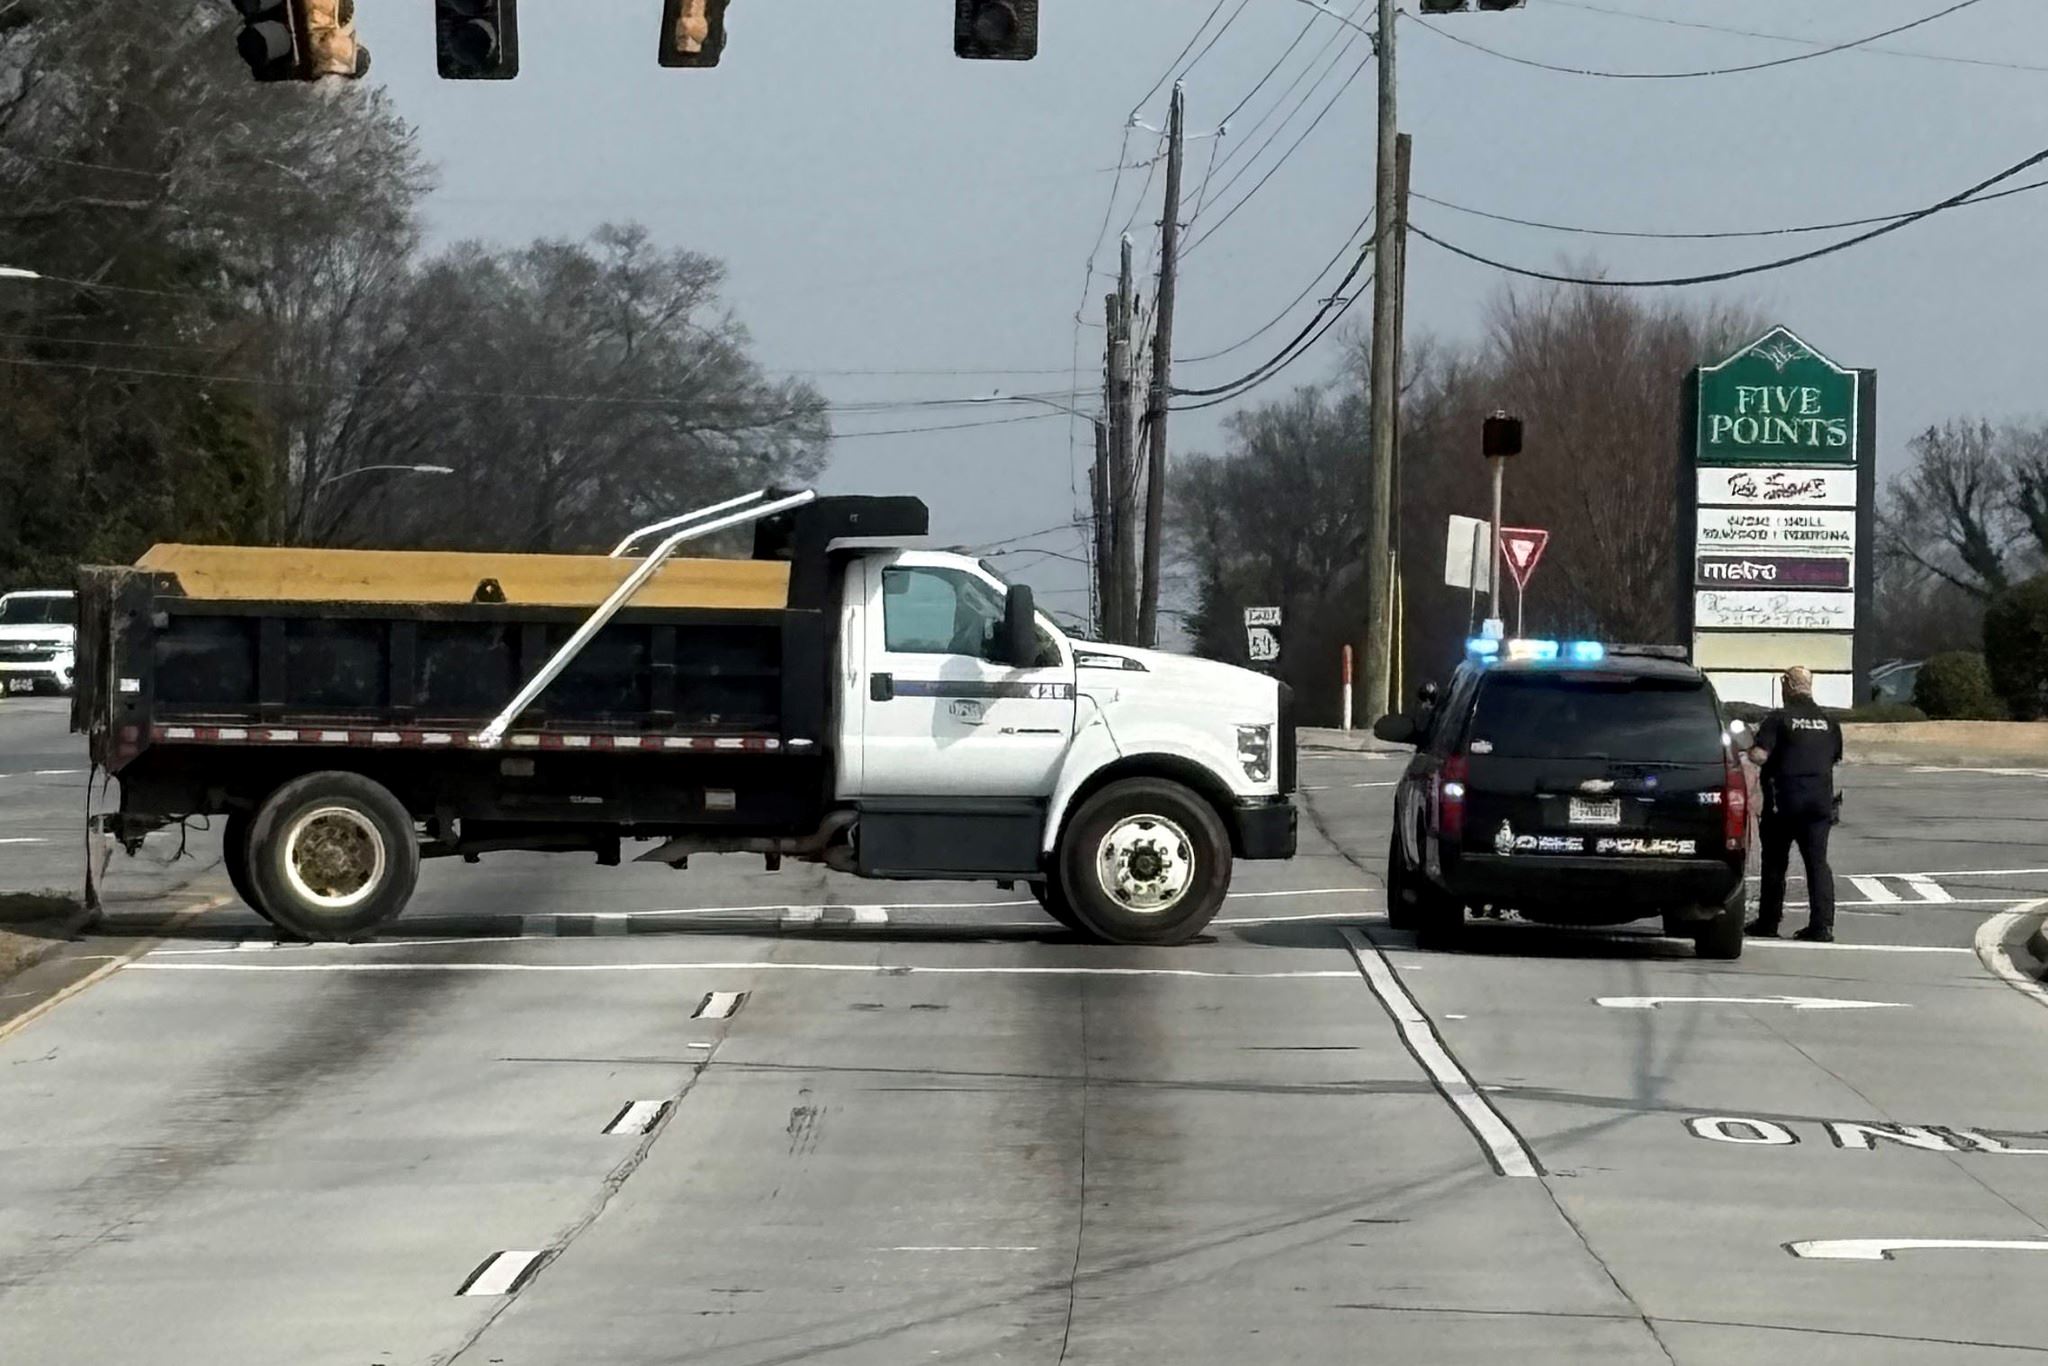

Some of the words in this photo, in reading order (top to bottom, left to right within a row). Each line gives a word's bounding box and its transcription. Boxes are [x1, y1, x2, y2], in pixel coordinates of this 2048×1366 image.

[1735, 386, 1821, 415] FIVE
[1708, 414, 1848, 446] POINTS
[1703, 561, 1777, 580] metro
[1596, 837, 1697, 854] POLICE
